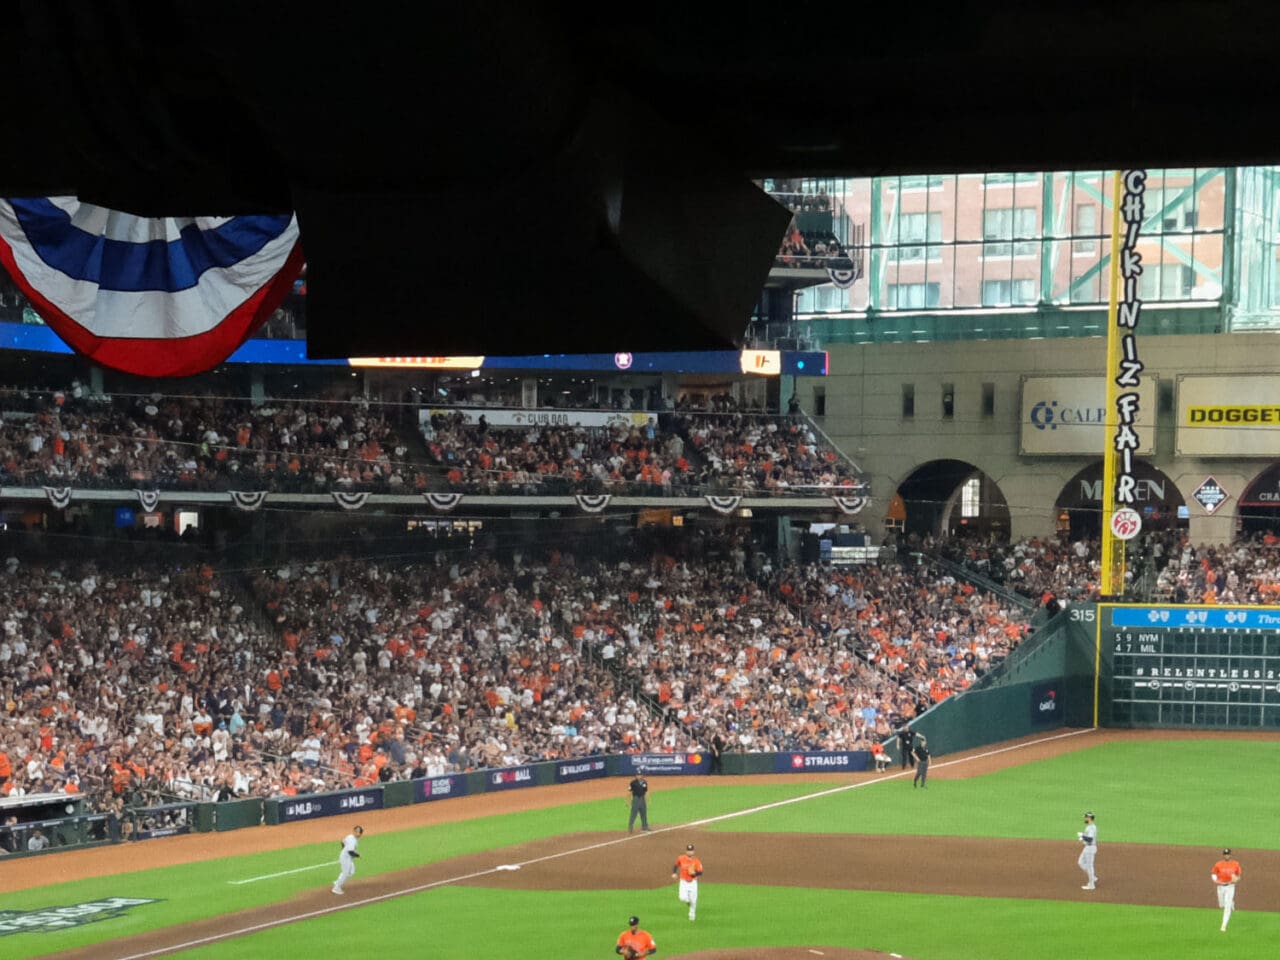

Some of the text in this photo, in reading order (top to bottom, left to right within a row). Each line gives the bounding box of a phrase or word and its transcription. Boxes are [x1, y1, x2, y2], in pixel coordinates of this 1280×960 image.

[1116, 169, 1146, 503] CHIKIN IZ FAIR
[1081, 480, 1165, 500] MEN
[1070, 609, 1095, 622] 315
[1139, 634, 1159, 642] NYM
[1141, 645, 1156, 653] MIL
[805, 756, 849, 766] STRAUSS
[349, 795, 365, 808] MLB
[295, 803, 311, 815] MLB
